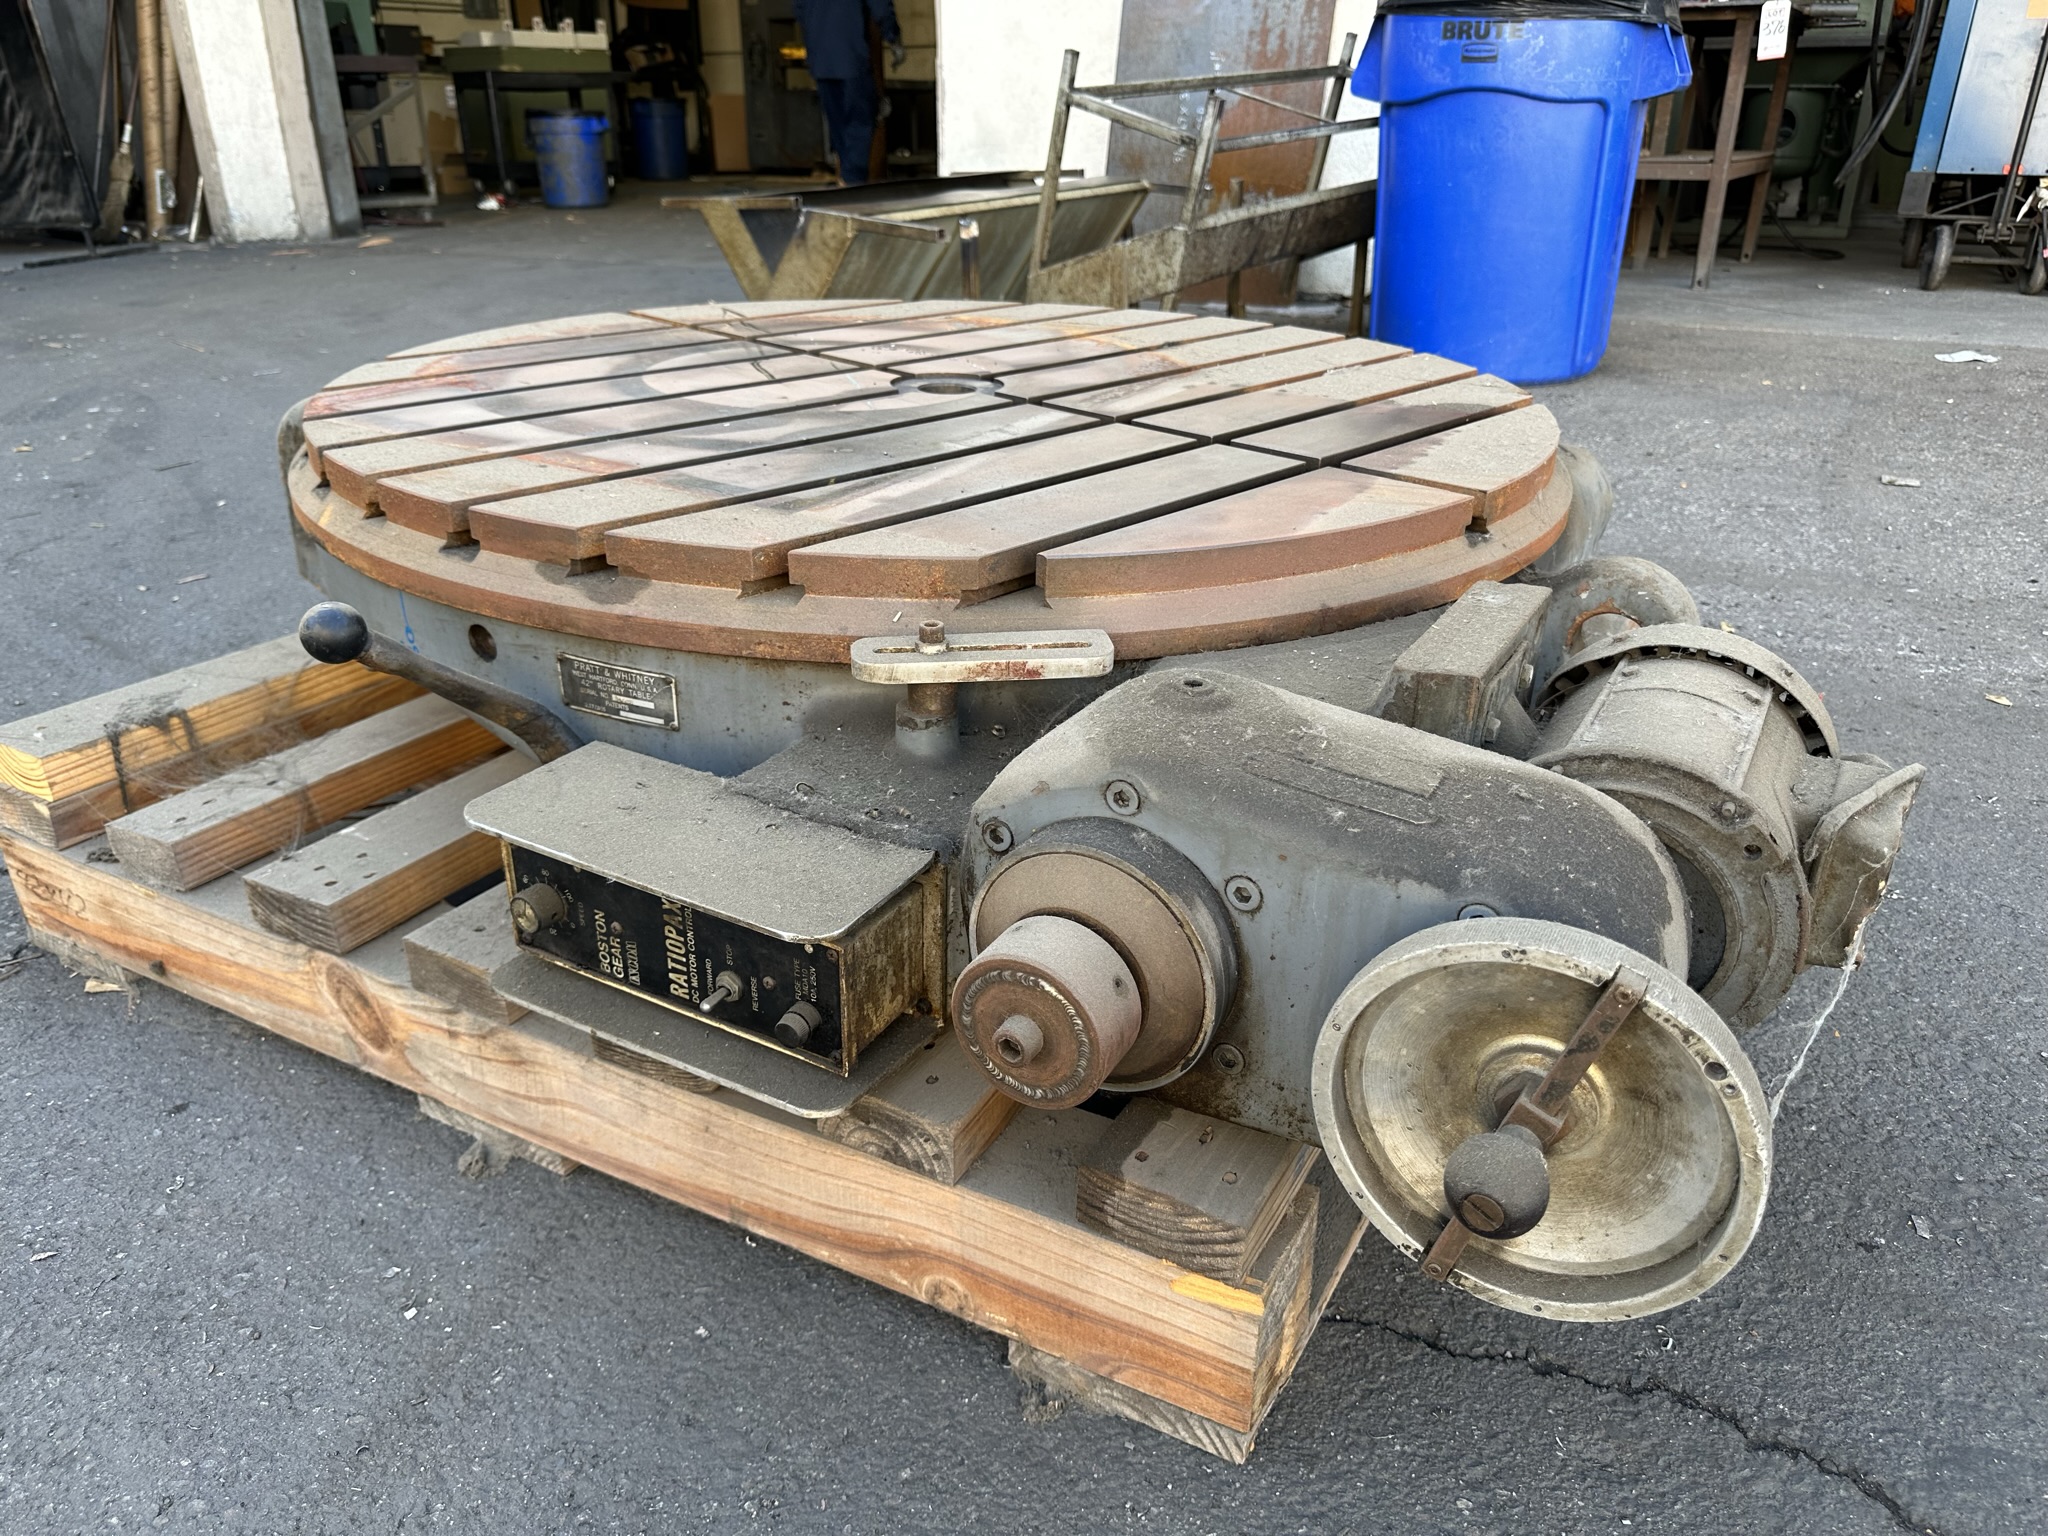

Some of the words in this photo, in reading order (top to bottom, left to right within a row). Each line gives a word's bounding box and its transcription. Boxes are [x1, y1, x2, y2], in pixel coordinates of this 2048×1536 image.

[1442, 20, 1525, 40] BRUTE
[1762, 20, 1786, 36] 376
[574, 661, 600, 674] PRATT
[604, 668, 610, 677] &
[614, 670, 655, 686] WHITNEY
[597, 683, 625, 695] ROTARY
[629, 689, 651, 700] TABLE
[605, 700, 630, 711] PATENTS
[594, 909, 611, 973] BOSTON
[684, 907, 696, 951] CONTROL
[610, 935, 625, 978] GEAR
[661, 897, 690, 1000] RATIOPAX
[688, 953, 699, 988] MOTOR
[809, 965, 817, 986] 250V
[691, 989, 700, 1004] DC
[750, 976, 759, 1011] REVERSE
